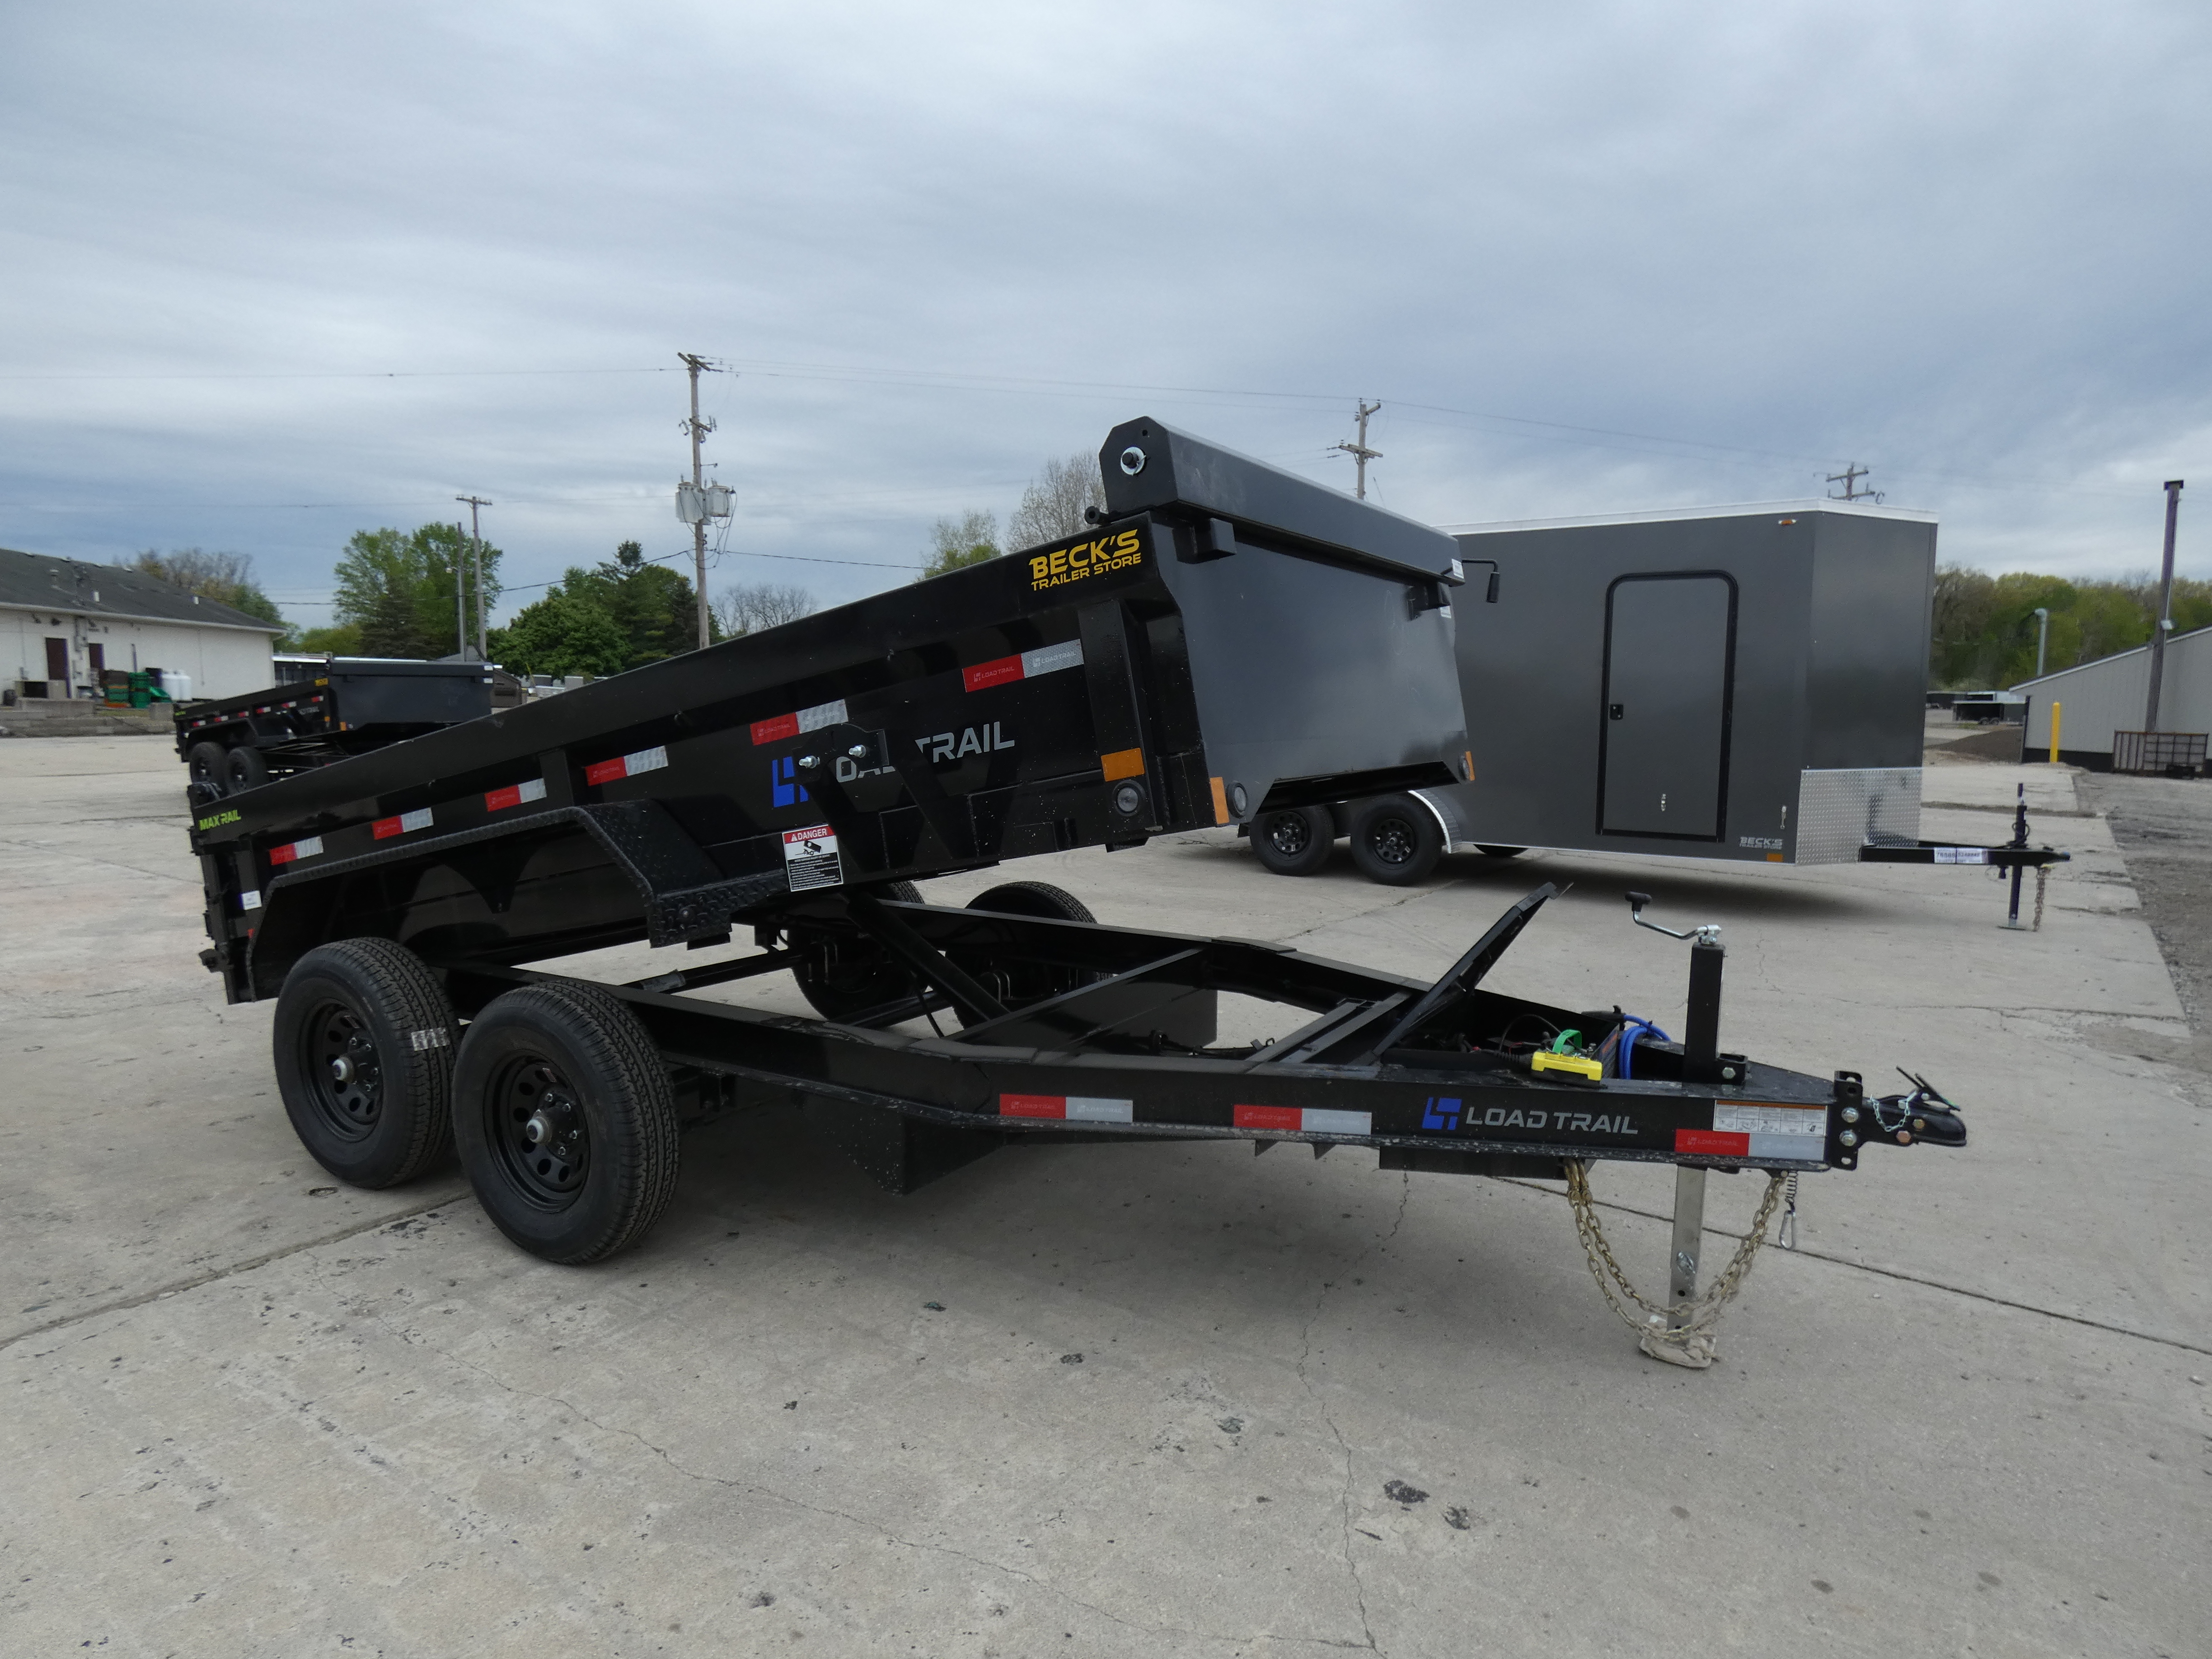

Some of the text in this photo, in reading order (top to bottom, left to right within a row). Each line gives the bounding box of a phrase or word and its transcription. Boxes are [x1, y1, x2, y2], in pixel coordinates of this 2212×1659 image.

[1028, 529, 1140, 579] BECK'S
[1031, 552, 1141, 591] TRAILER STORE
[1041, 651, 1076, 663] LOAD TRAIL
[981, 666, 1015, 679] LOAD TRAIL
[797, 829, 827, 840] DANGER
[1740, 837, 1783, 846] BECK'S
[1466, 1107, 1638, 1134] LOAD TRAIL
